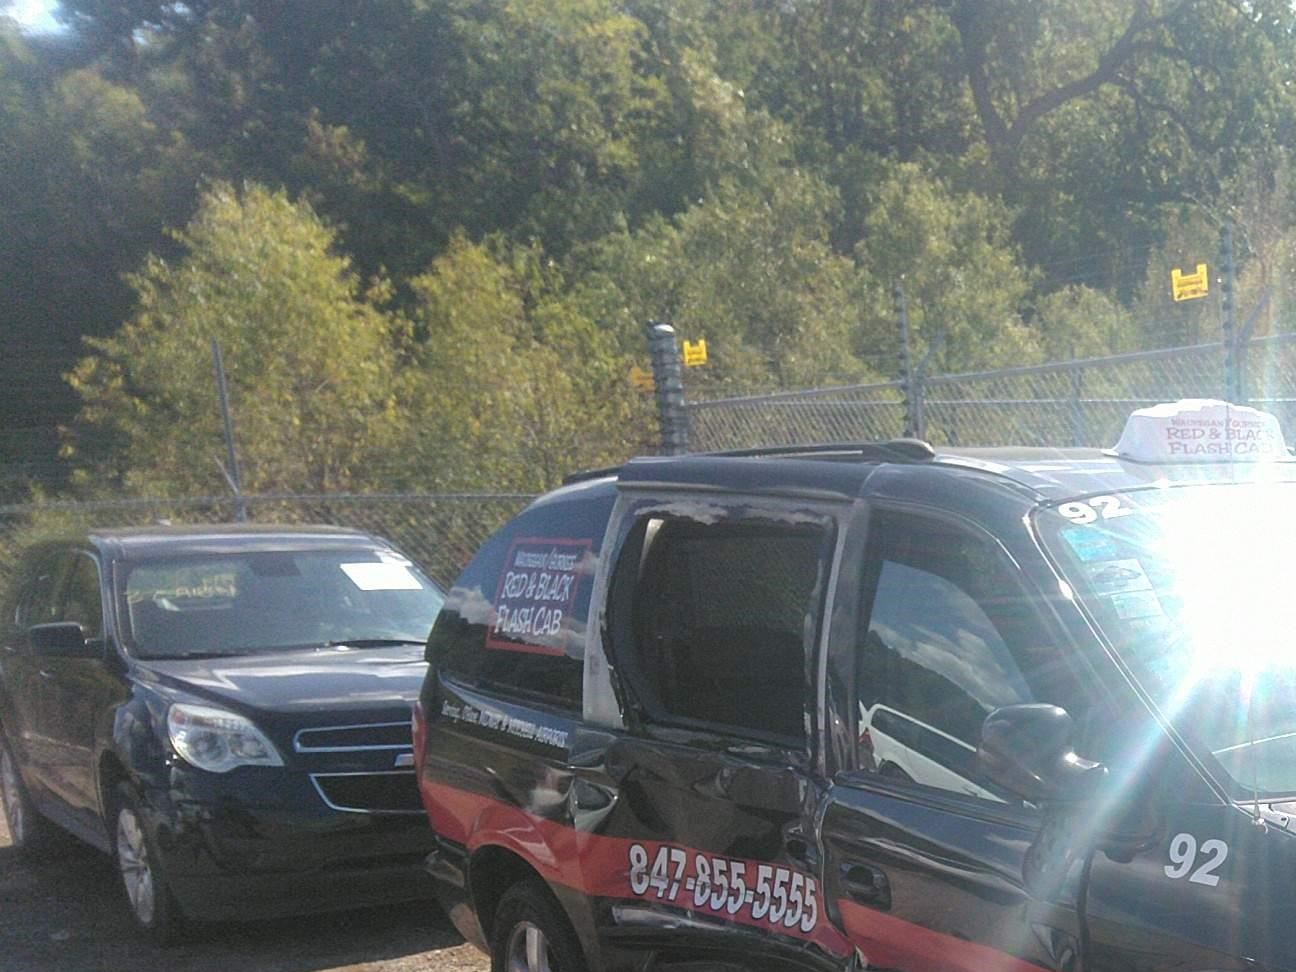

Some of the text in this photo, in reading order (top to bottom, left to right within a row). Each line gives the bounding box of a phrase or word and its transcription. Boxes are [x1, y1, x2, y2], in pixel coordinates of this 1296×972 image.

[1166, 426, 1205, 440] RED
[1208, 426, 1222, 440] &
[1168, 441, 1229, 455] FLASH
[1058, 495, 1133, 525] 92
[501, 571, 575, 602] RED & BLACK
[494, 604, 562, 636] FLASH CAB
[1164, 832, 1228, 887] 92
[629, 844, 817, 932] 847-855-5555
